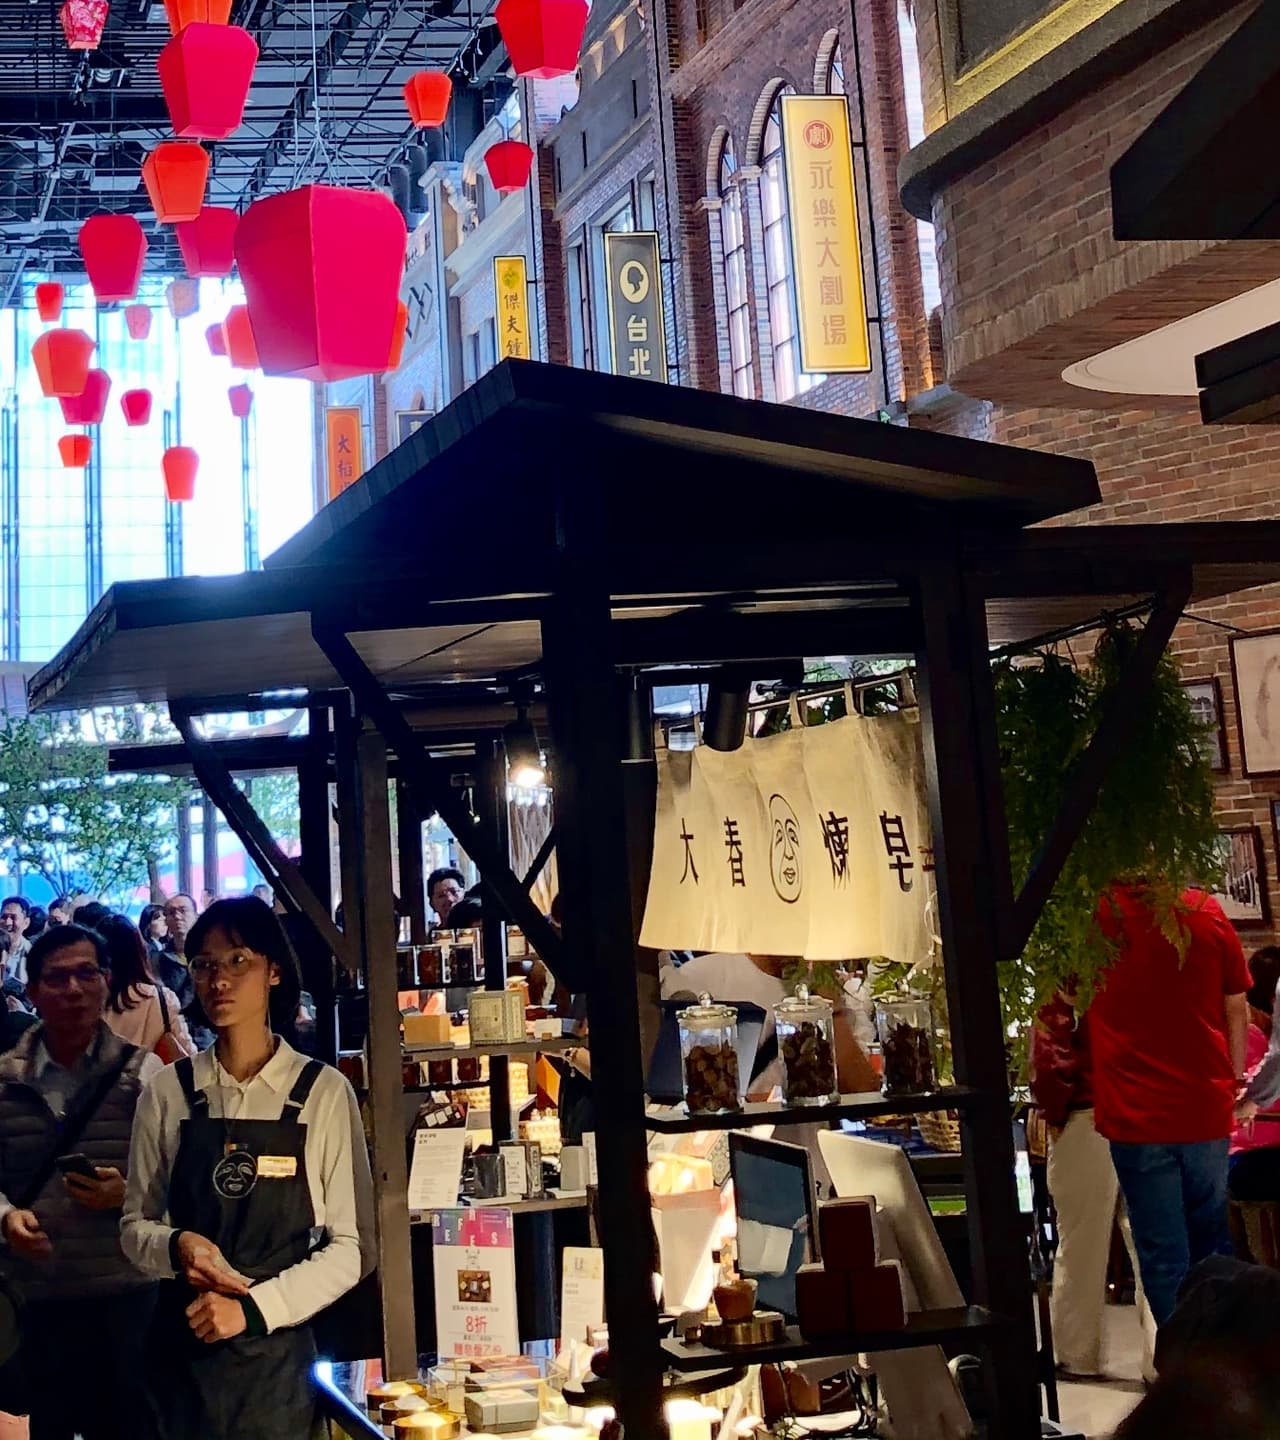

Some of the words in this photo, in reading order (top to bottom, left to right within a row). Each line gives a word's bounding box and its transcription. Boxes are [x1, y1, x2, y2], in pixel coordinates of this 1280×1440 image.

[808, 160, 848, 346] 永樂大劇場
[627, 314, 652, 377] 台北
